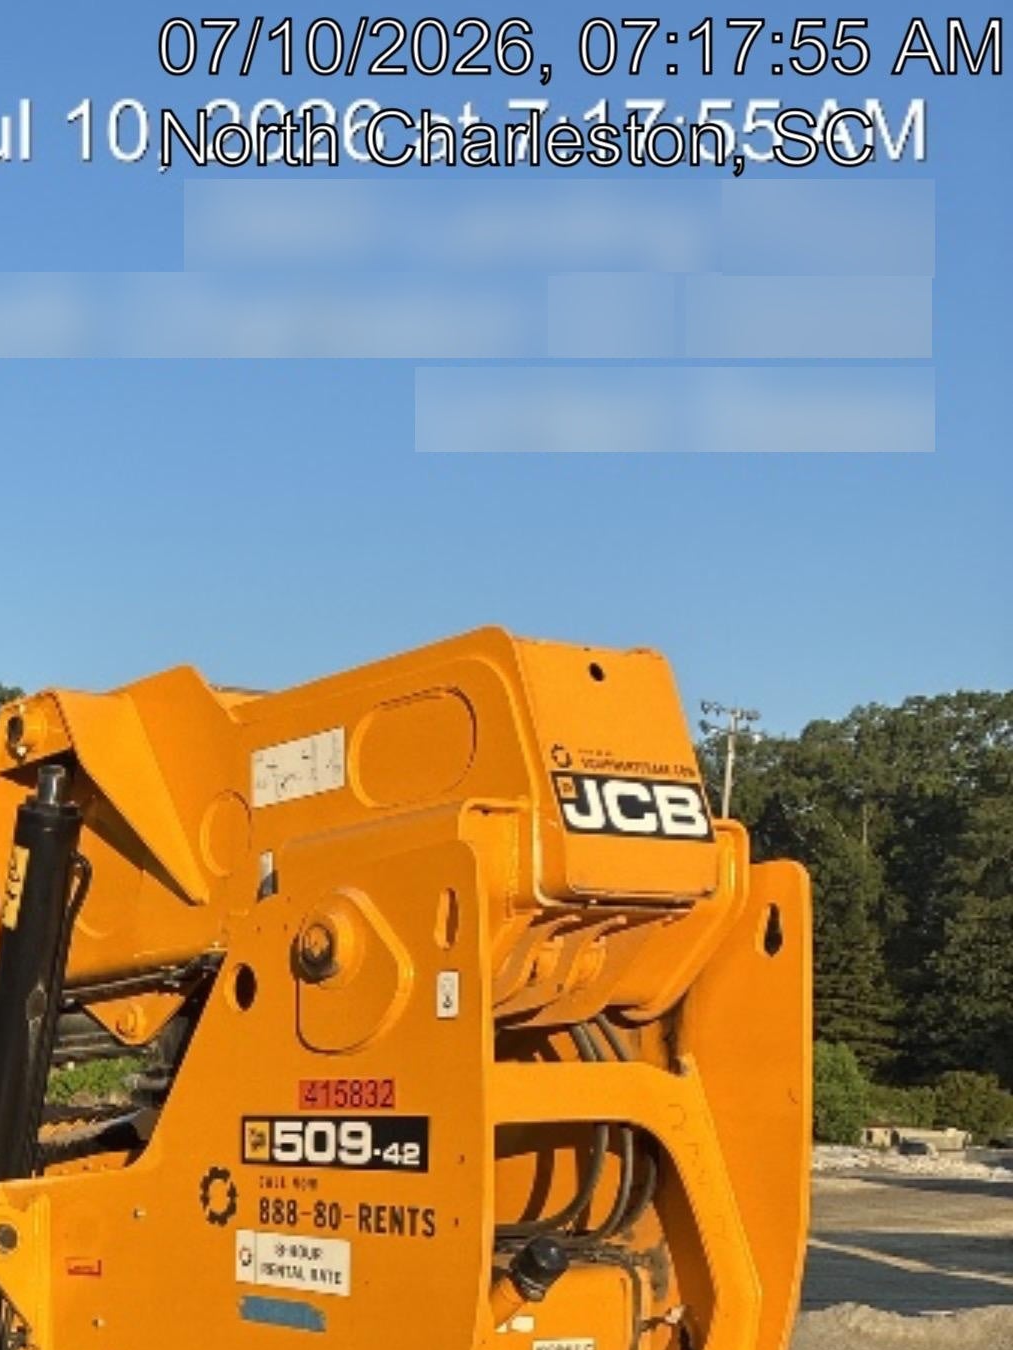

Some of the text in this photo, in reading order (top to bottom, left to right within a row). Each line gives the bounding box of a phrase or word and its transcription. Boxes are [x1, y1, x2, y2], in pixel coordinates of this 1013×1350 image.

[563, 779, 708, 835] JCB
[304, 1079, 395, 1108] 415832
[259, 1197, 436, 1238] 888-80-RENTS
